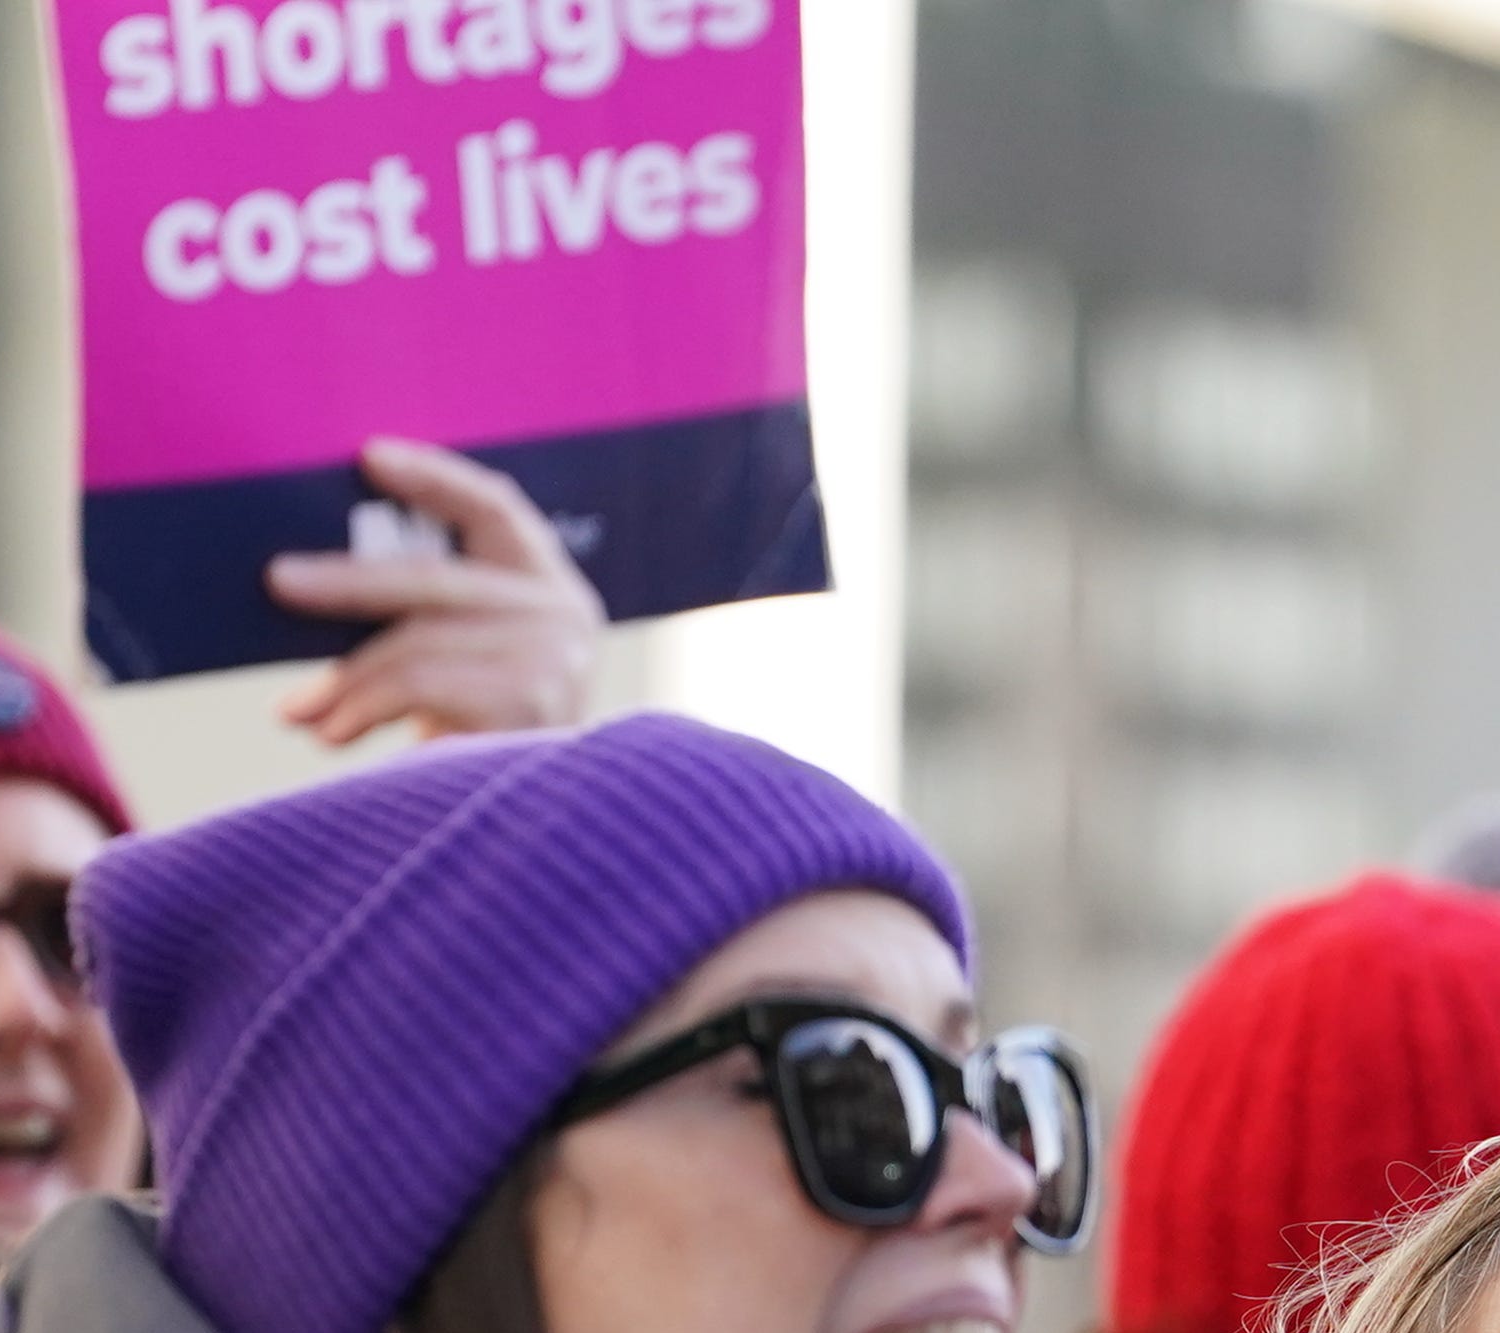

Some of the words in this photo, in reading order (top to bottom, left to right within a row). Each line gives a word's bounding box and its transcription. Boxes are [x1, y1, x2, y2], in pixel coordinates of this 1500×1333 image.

[102, 0, 770, 116] shortages
[145, 156, 432, 300] cost
[460, 122, 758, 264] lives
